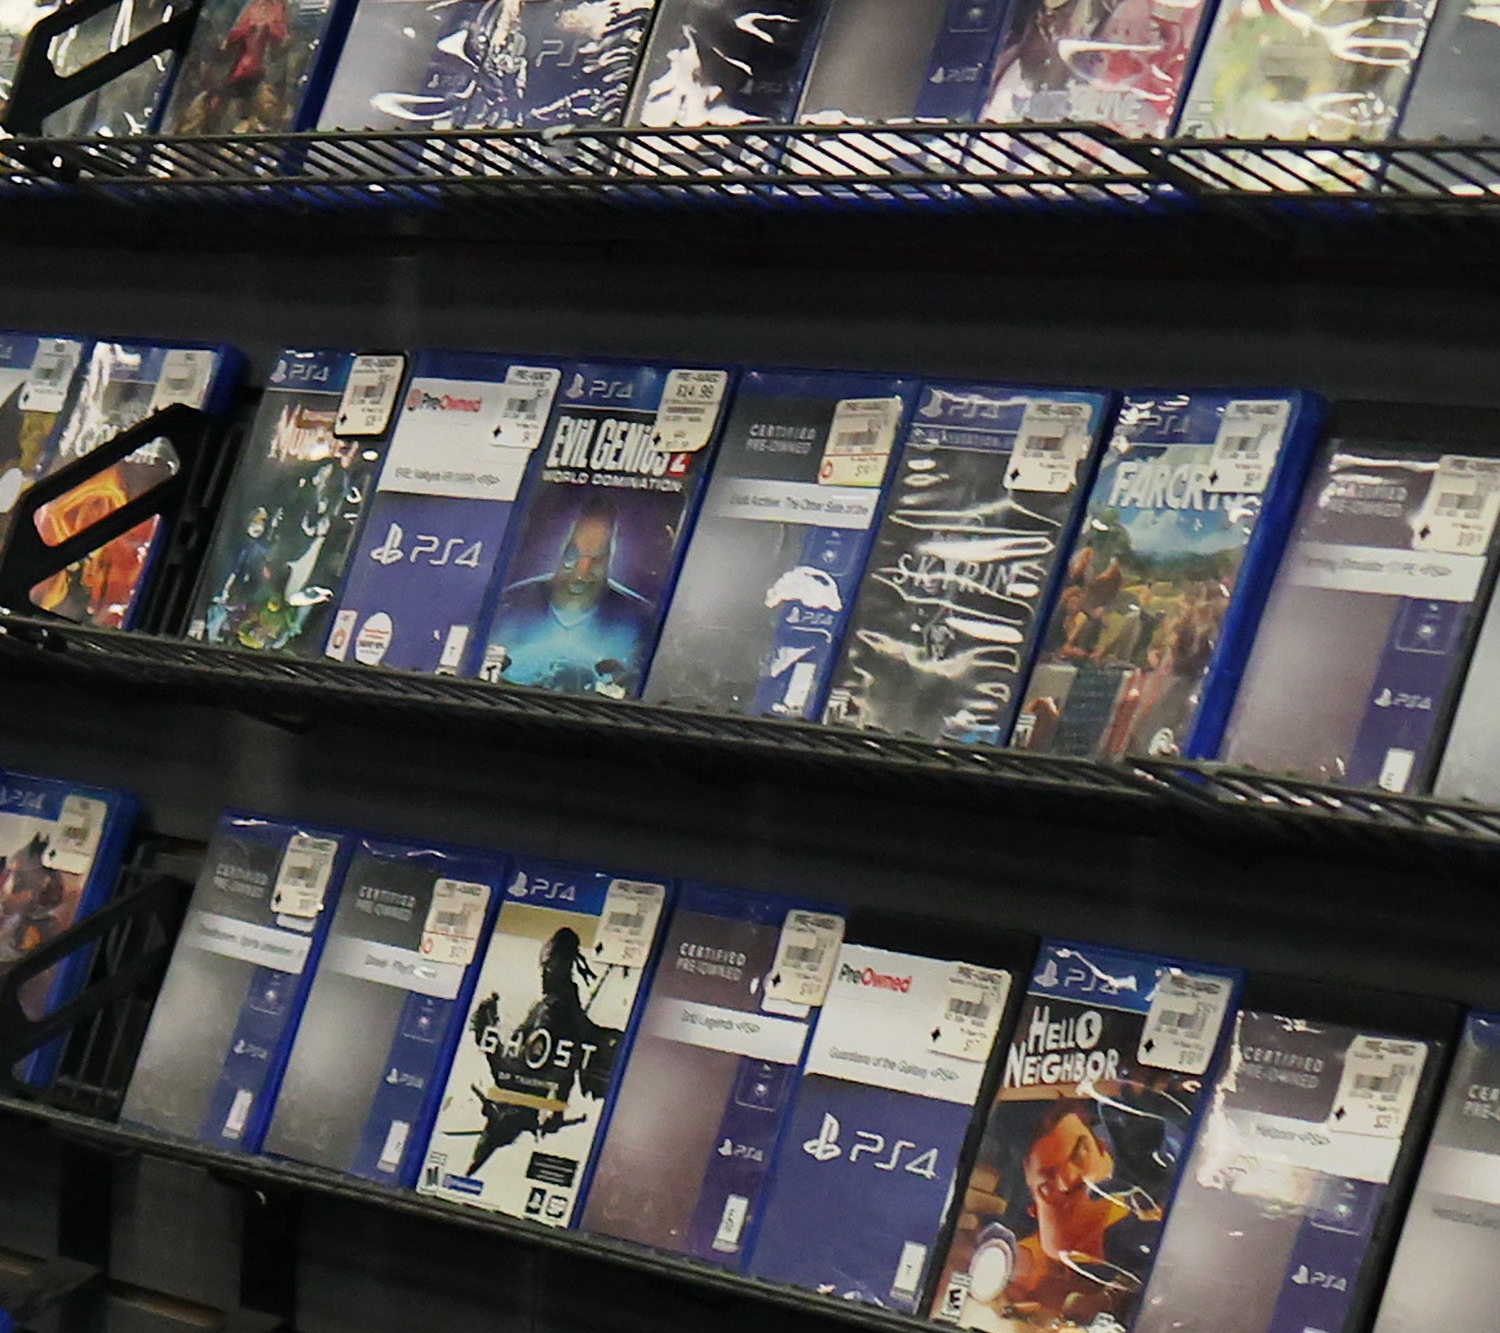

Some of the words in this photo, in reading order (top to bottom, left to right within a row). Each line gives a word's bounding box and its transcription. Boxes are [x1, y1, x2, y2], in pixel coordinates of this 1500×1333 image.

[589, 380, 634, 399] PS4
[749, 423, 817, 440] CERTIFIED
[542, 469, 590, 485] WORLD
[592, 472, 683, 492] DOMINATION
[410, 534, 483, 568] PS4
[529, 878, 576, 902] PS4
[679, 942, 746, 967] CERTIFIED
[838, 963, 913, 994] PreOwned
[1028, 1004, 1103, 1050] HELLO
[479, 1027, 599, 1071] GHOST
[1243, 1045, 1325, 1072] CERTIFIED
[850, 1130, 940, 1180] PS4
